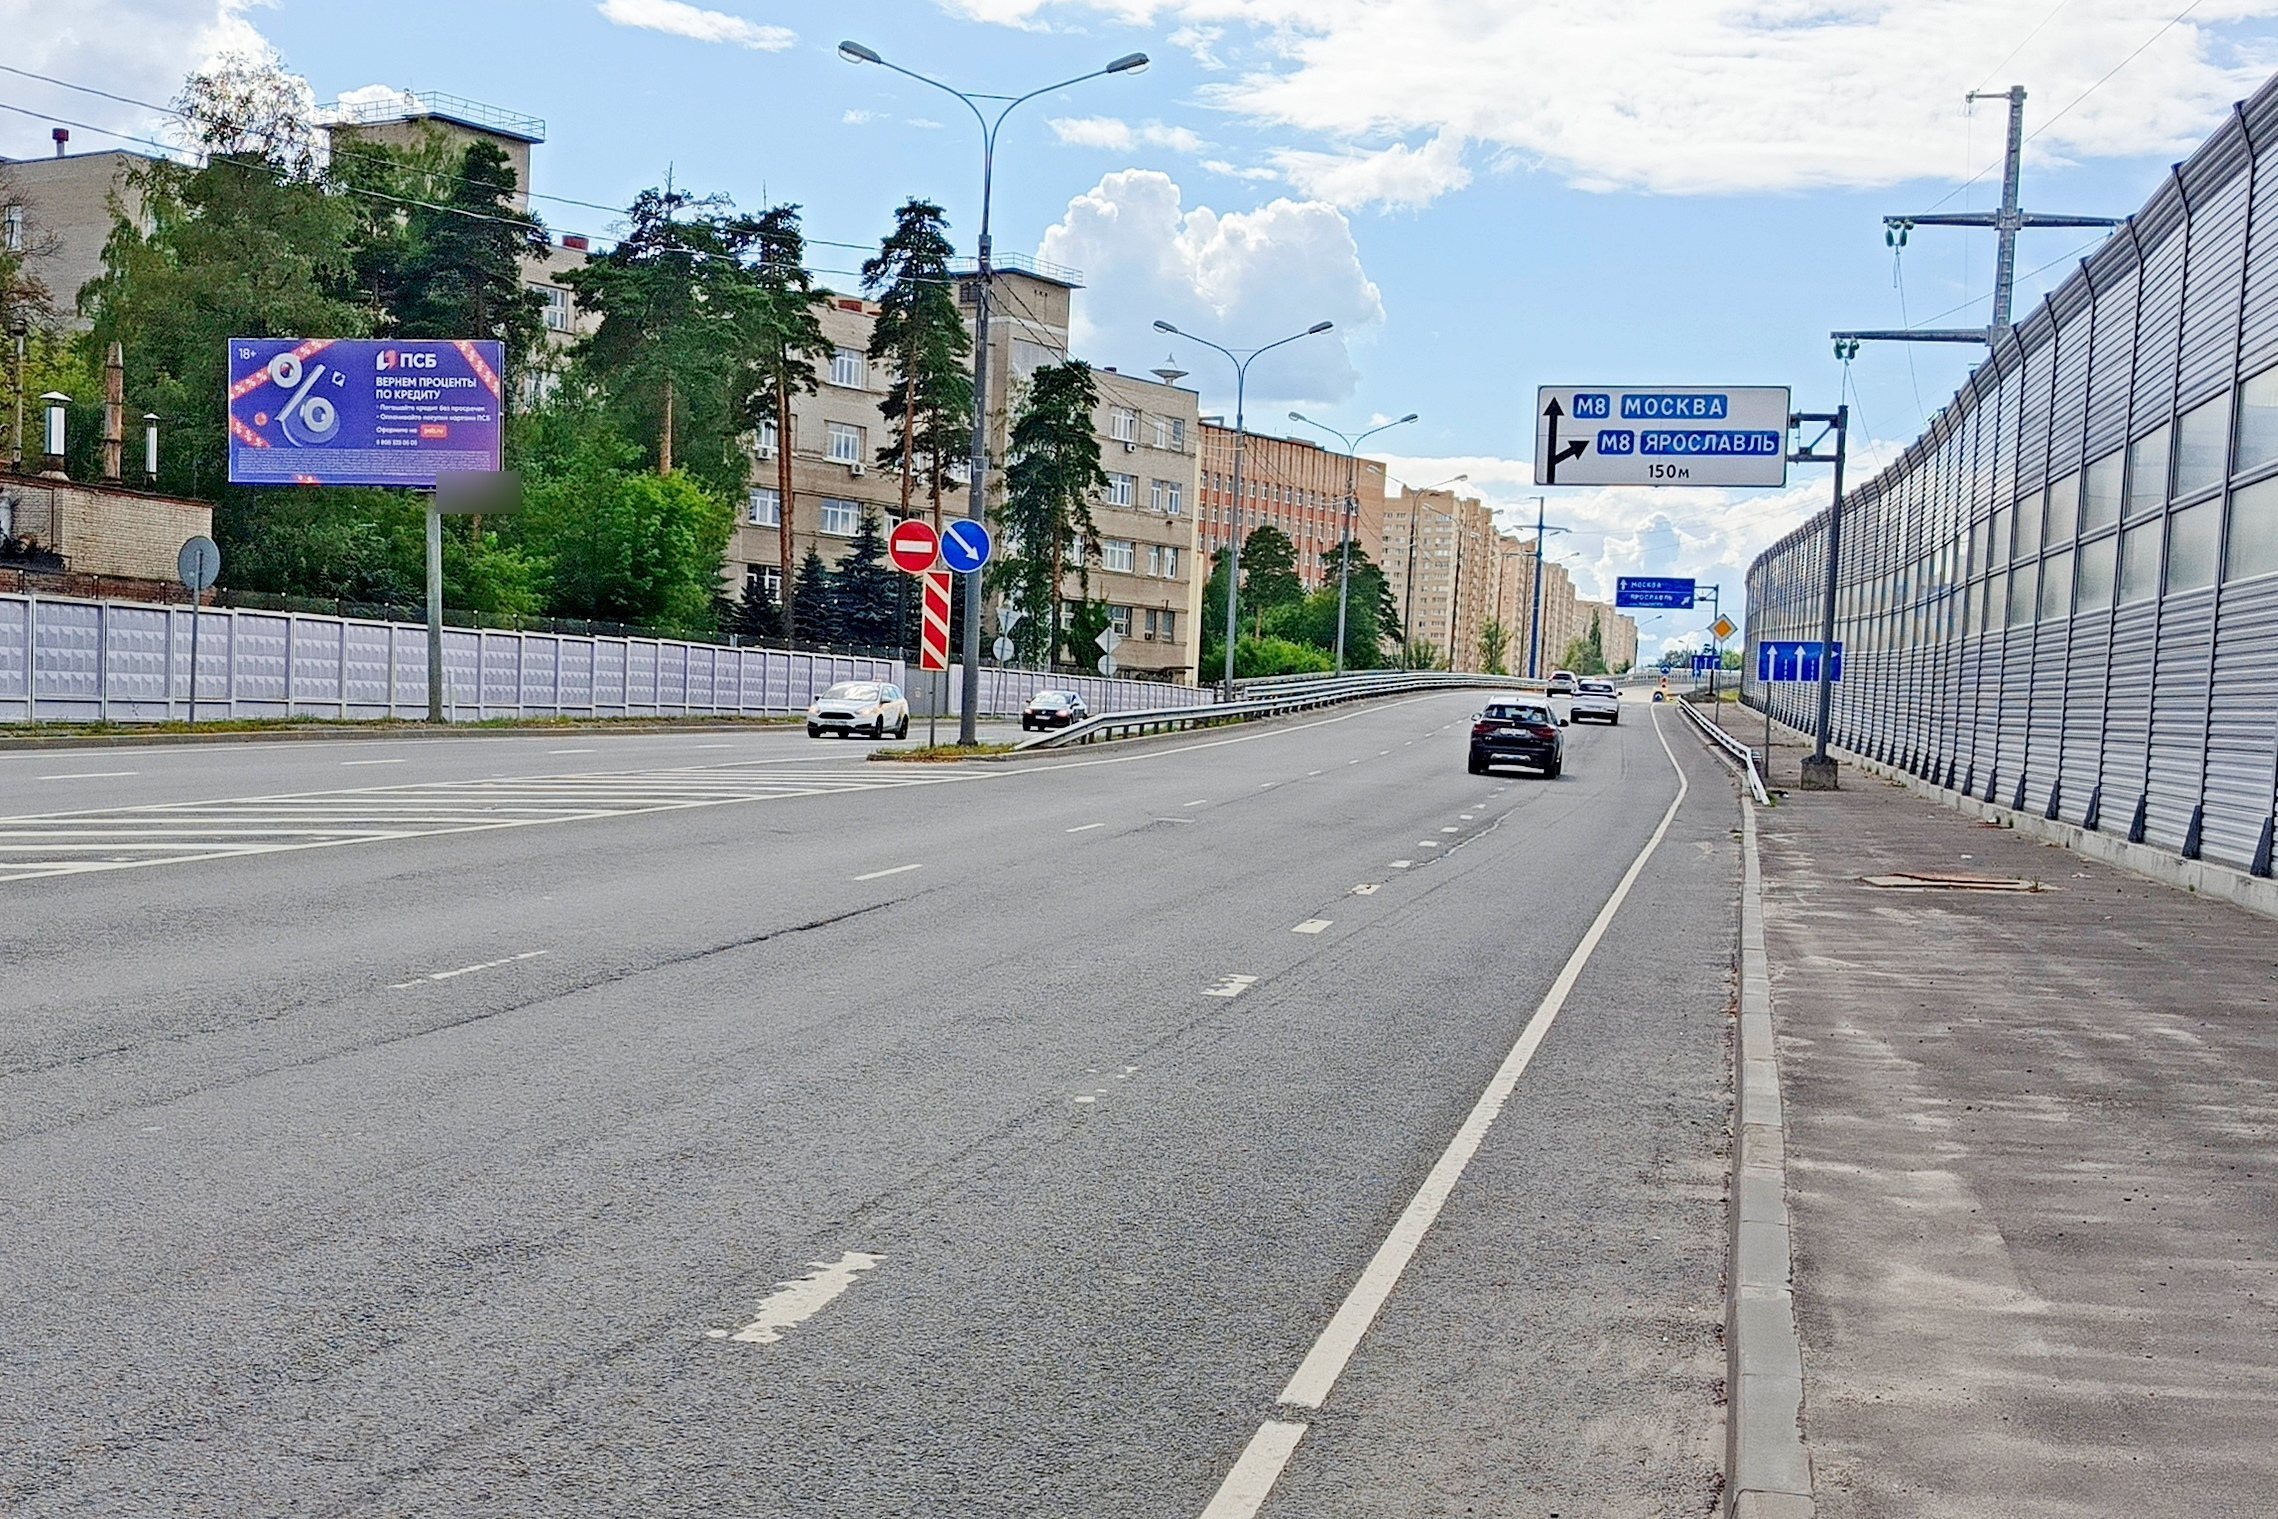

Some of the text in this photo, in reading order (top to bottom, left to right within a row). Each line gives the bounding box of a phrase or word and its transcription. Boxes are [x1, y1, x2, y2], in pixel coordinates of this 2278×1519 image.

[238, 348, 257, 360] 18+
[401, 353, 437, 368] ПСБ
[376, 376, 477, 389] ВЕРНЕМ ПРОЦЕНТЫ
[376, 389, 440, 401] ПО КРЕДИТУ
[1577, 398, 1723, 416] М8 МОСКВА
[1601, 434, 1776, 452] М8 ЯРОСЛАВЛЬ
